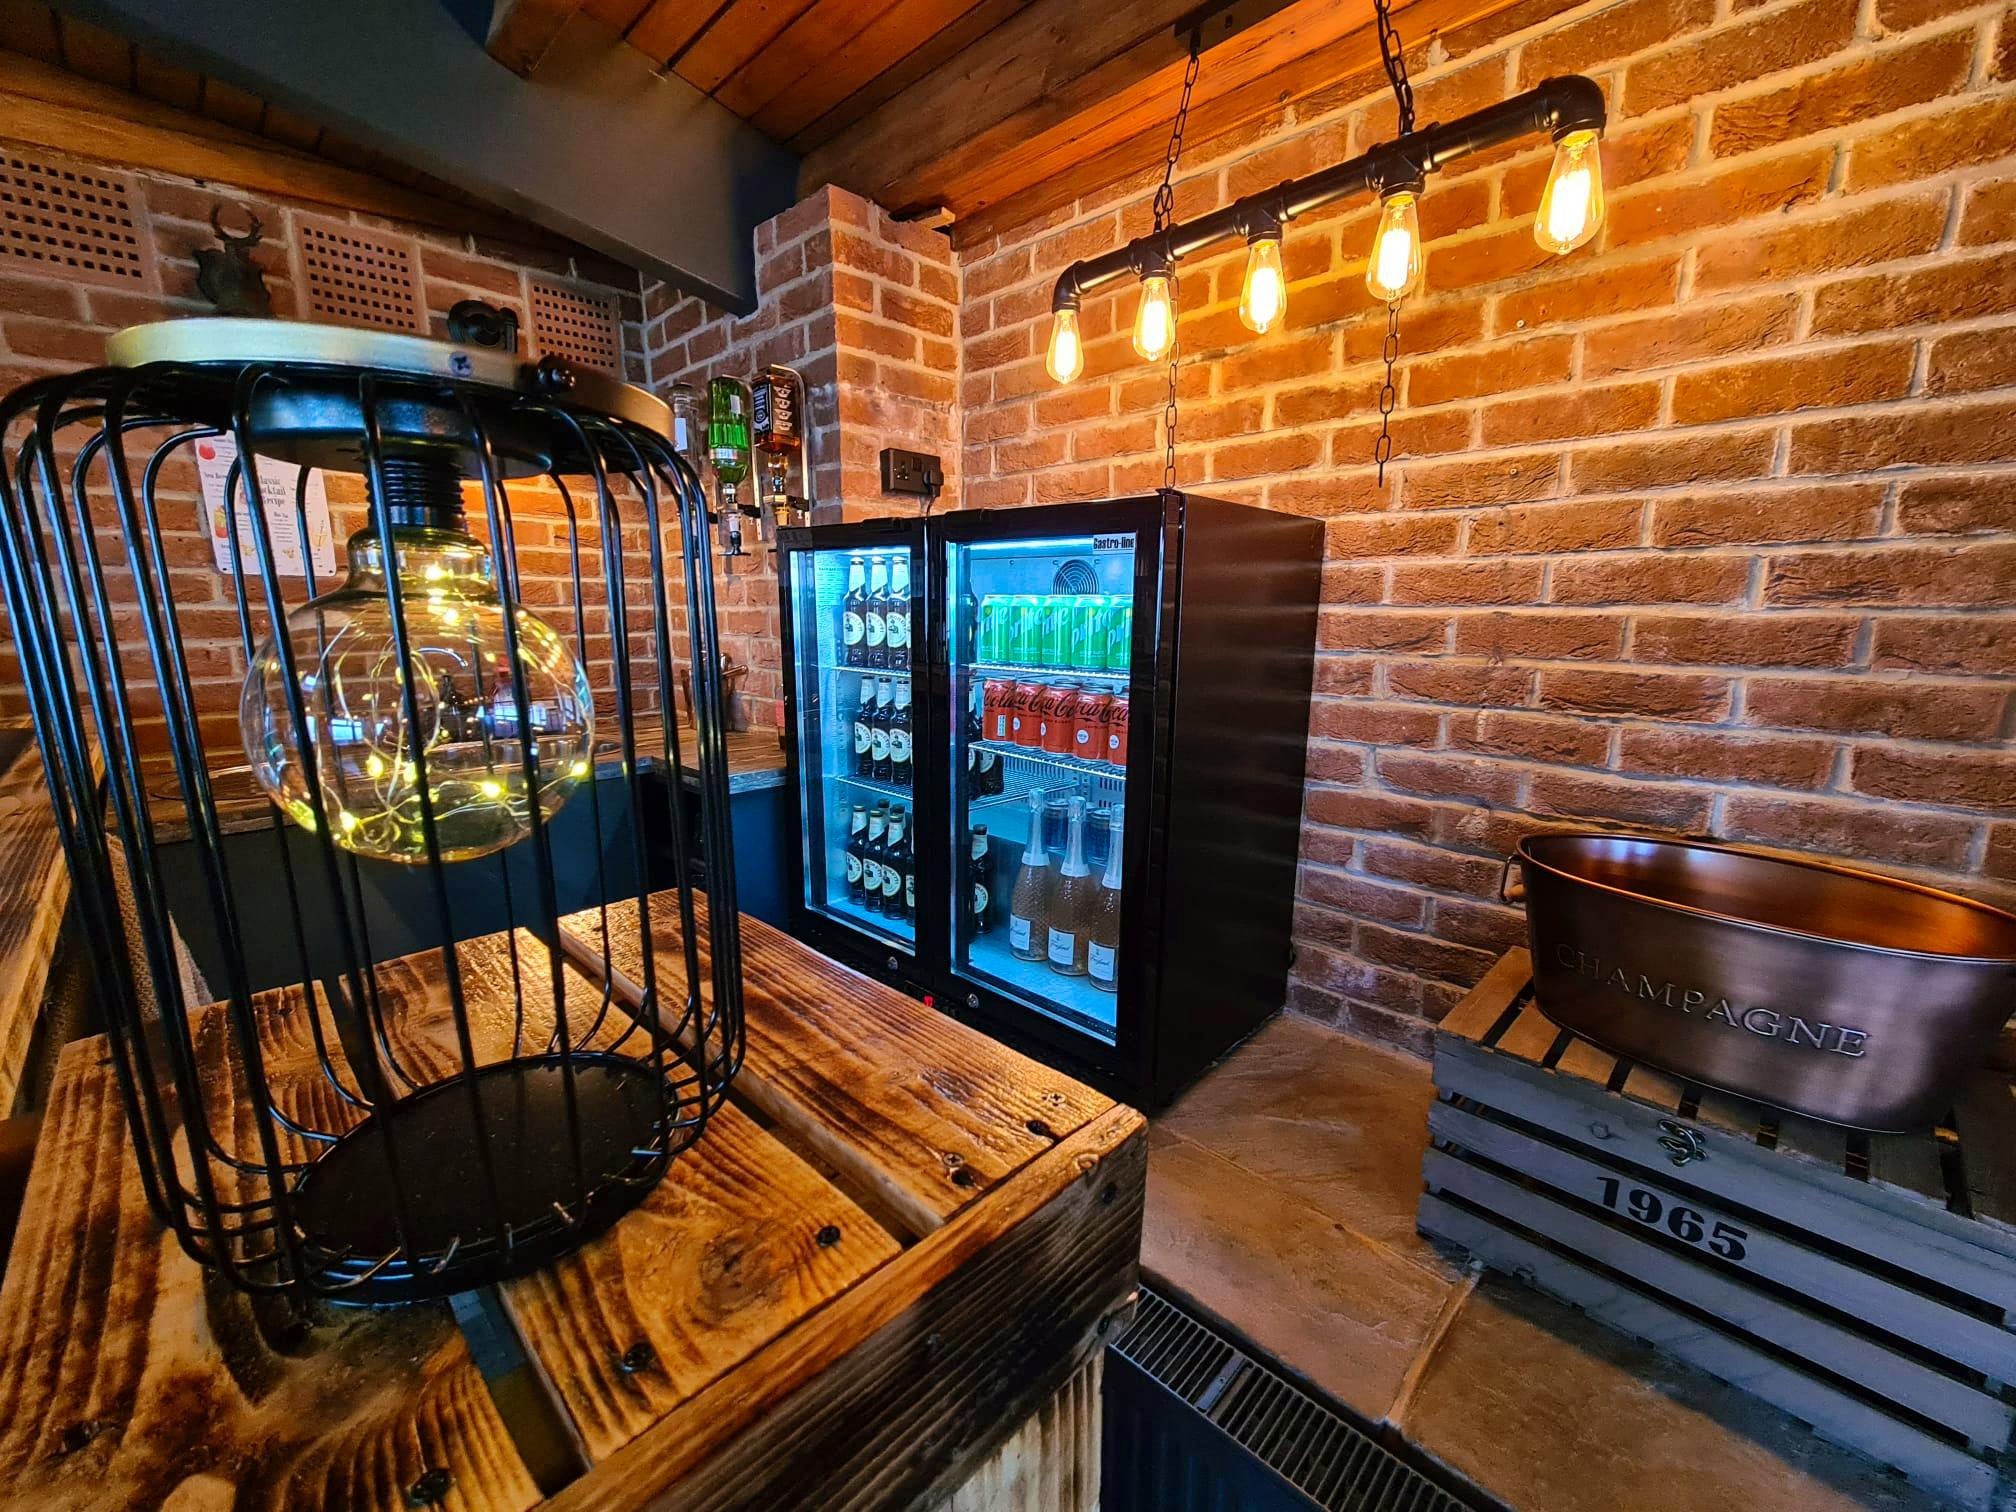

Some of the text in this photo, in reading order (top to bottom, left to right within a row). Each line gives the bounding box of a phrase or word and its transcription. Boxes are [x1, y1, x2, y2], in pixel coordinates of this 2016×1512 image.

[1093, 537, 1135, 549] Gastro-line
[1556, 943, 1871, 1058] CHAMPAGNE
[1595, 1176, 1748, 1261] 1965
